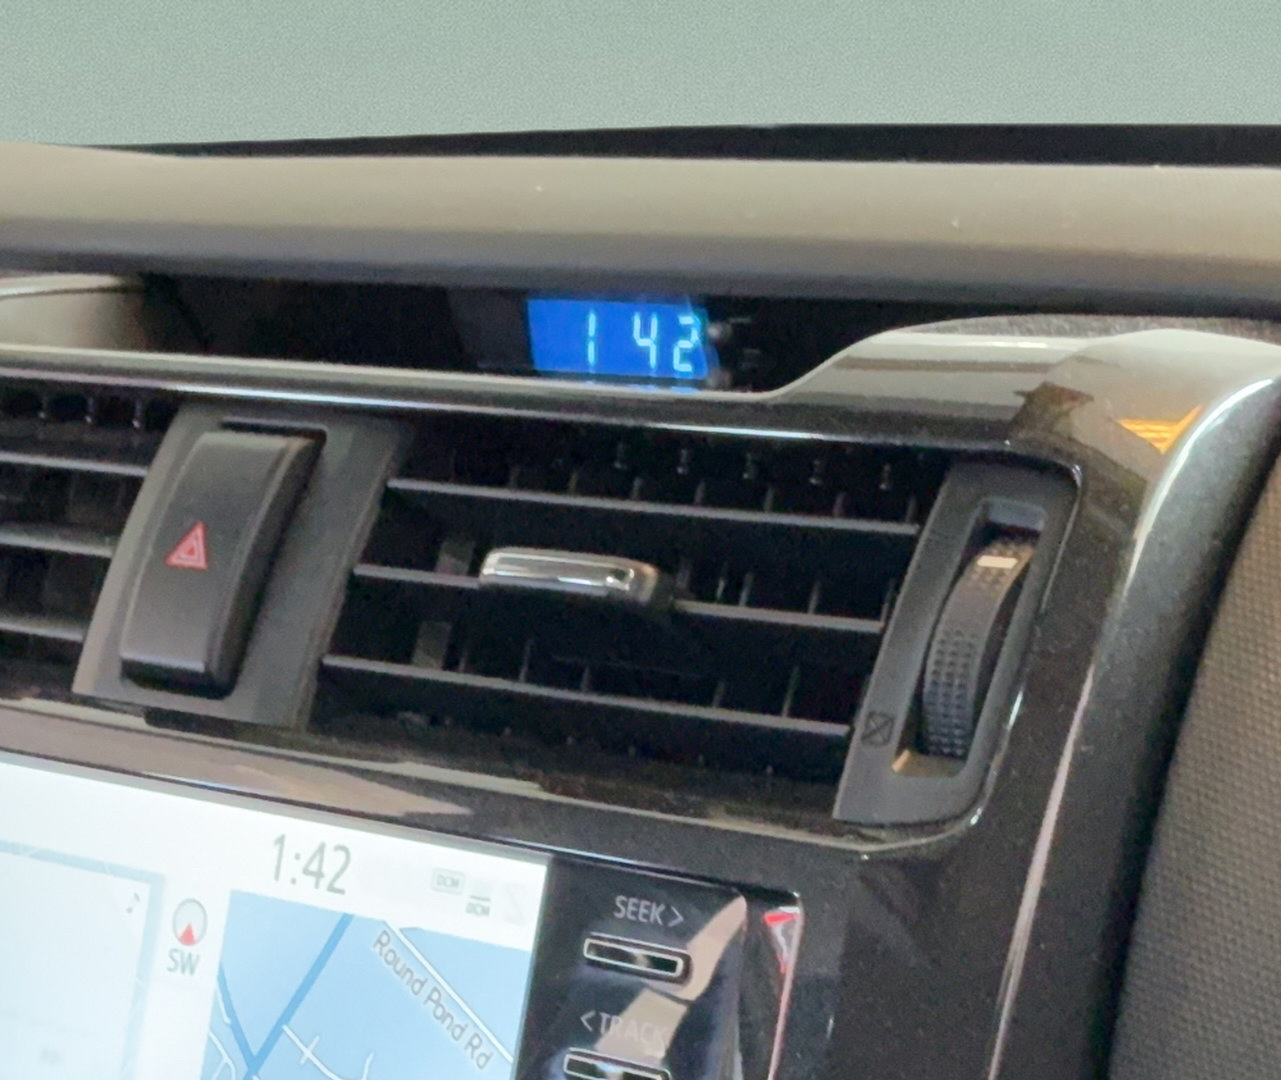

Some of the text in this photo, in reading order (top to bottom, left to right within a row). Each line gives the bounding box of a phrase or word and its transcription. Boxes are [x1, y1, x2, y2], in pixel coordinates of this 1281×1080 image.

[273, 834, 351, 895] 1:42
[613, 895, 664, 926] SEEK
[166, 947, 198, 975] SW
[373, 930, 494, 1069] Round Pond Rd
